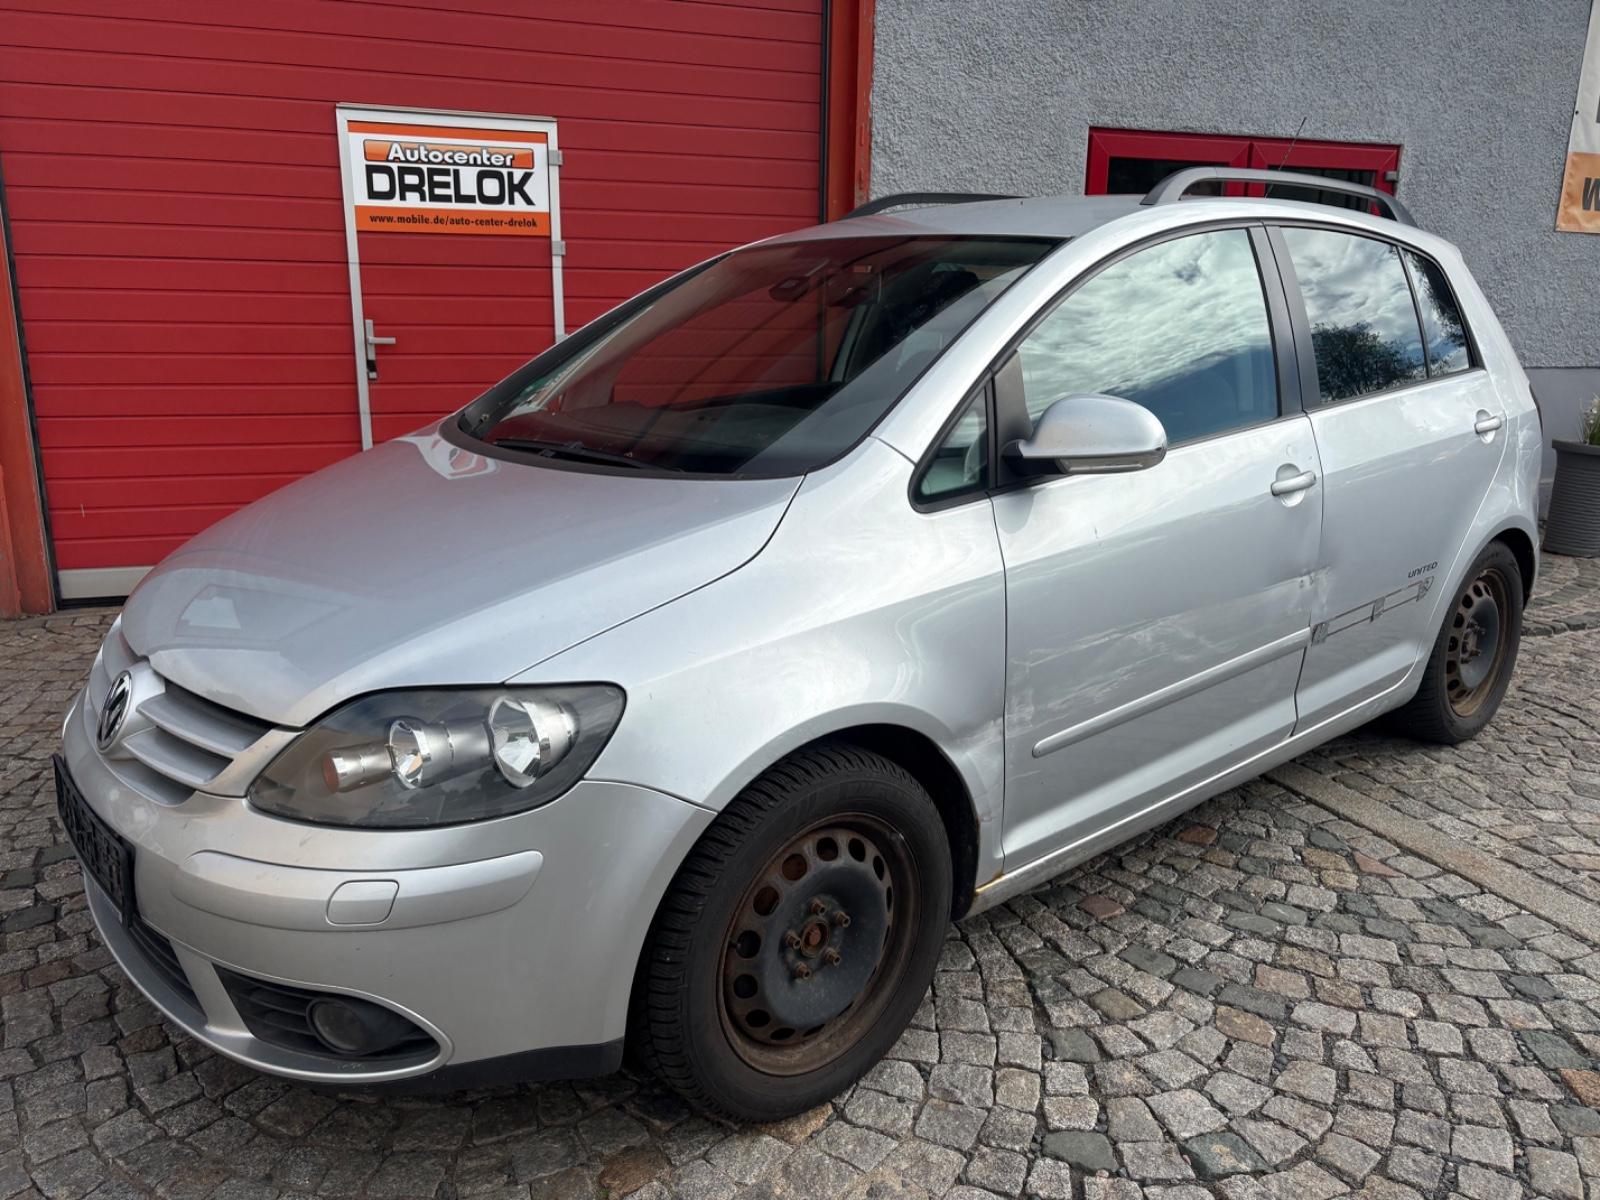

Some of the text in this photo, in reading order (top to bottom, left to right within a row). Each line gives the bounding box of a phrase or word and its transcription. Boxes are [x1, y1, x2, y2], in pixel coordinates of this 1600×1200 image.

[388, 142, 514, 167] Autocenter
[365, 164, 536, 206] DRELOK
[369, 214, 537, 228] www.mobile.de/auto-center-drelok
[1407, 561, 1438, 578] UNITED
